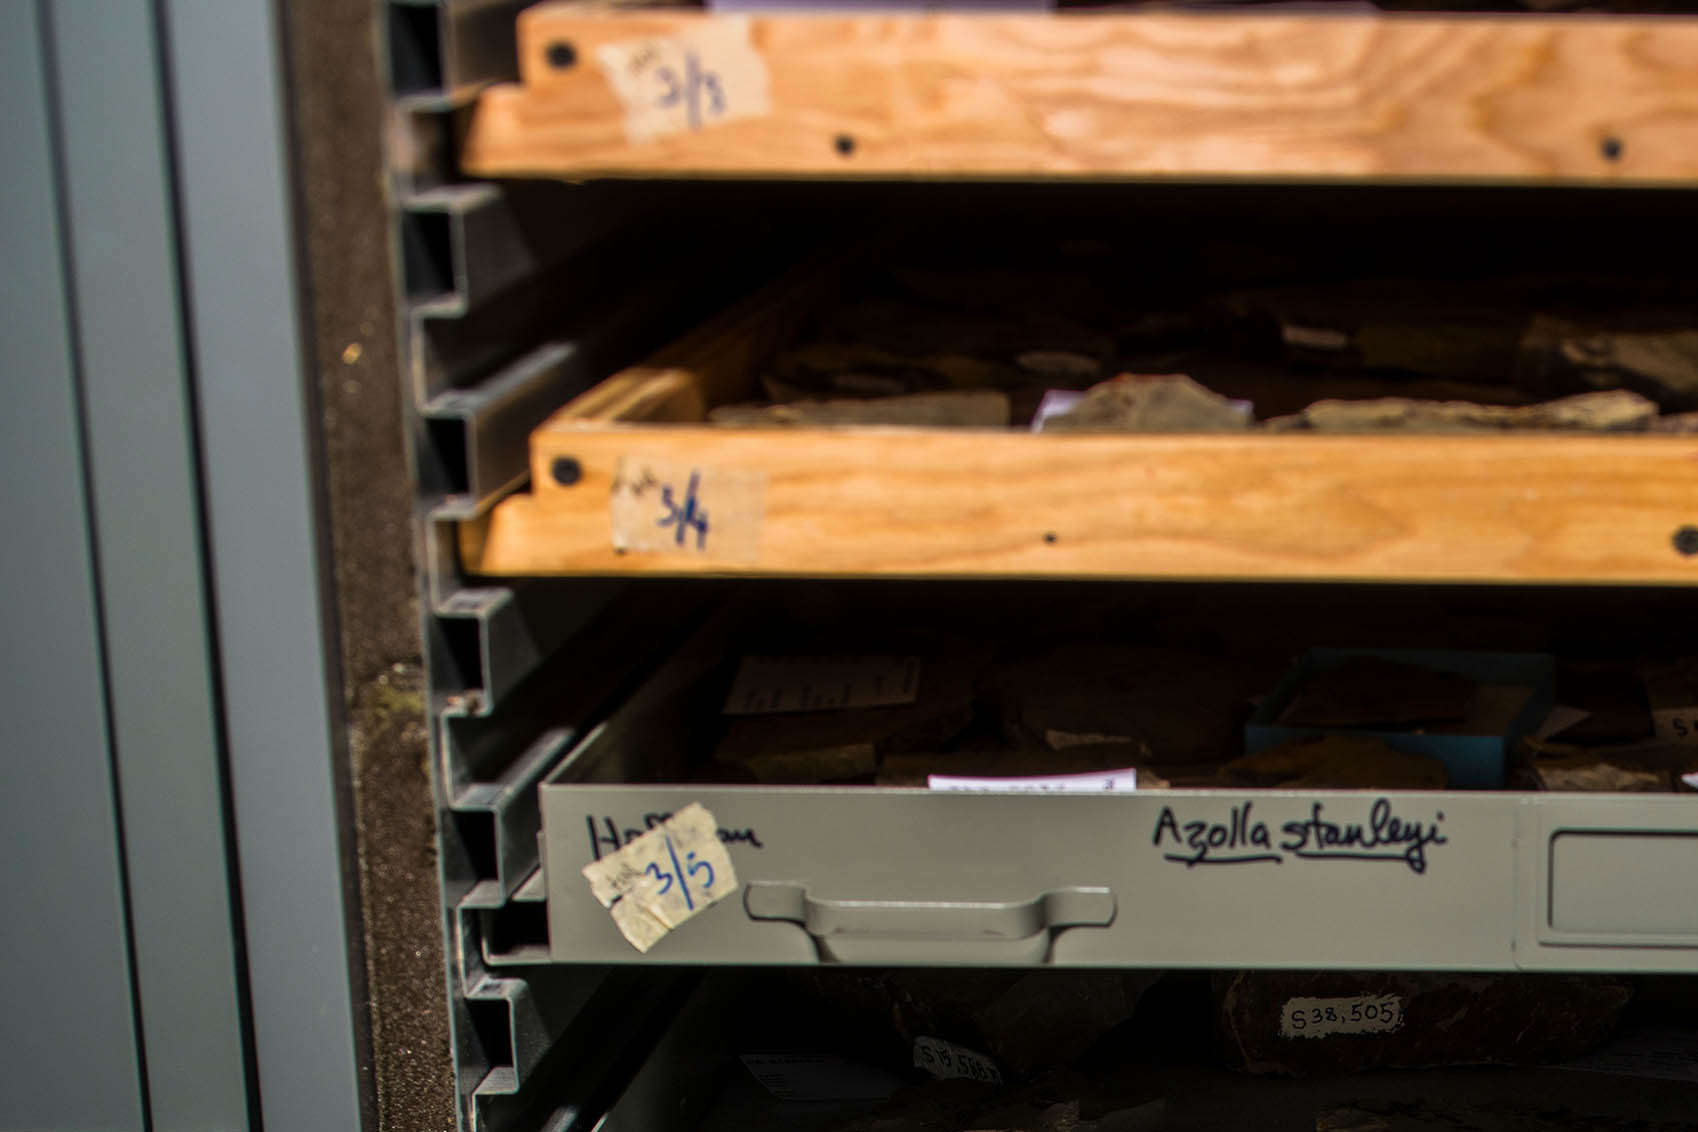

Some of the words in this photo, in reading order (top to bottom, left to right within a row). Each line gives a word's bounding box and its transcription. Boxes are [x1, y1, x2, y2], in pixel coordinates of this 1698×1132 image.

[645, 835, 716, 911] 3/5
[1152, 800, 1271, 866] Azolla
[1281, 797, 1448, 874] stanleyi
[1291, 1002, 1394, 1029] S38,505
